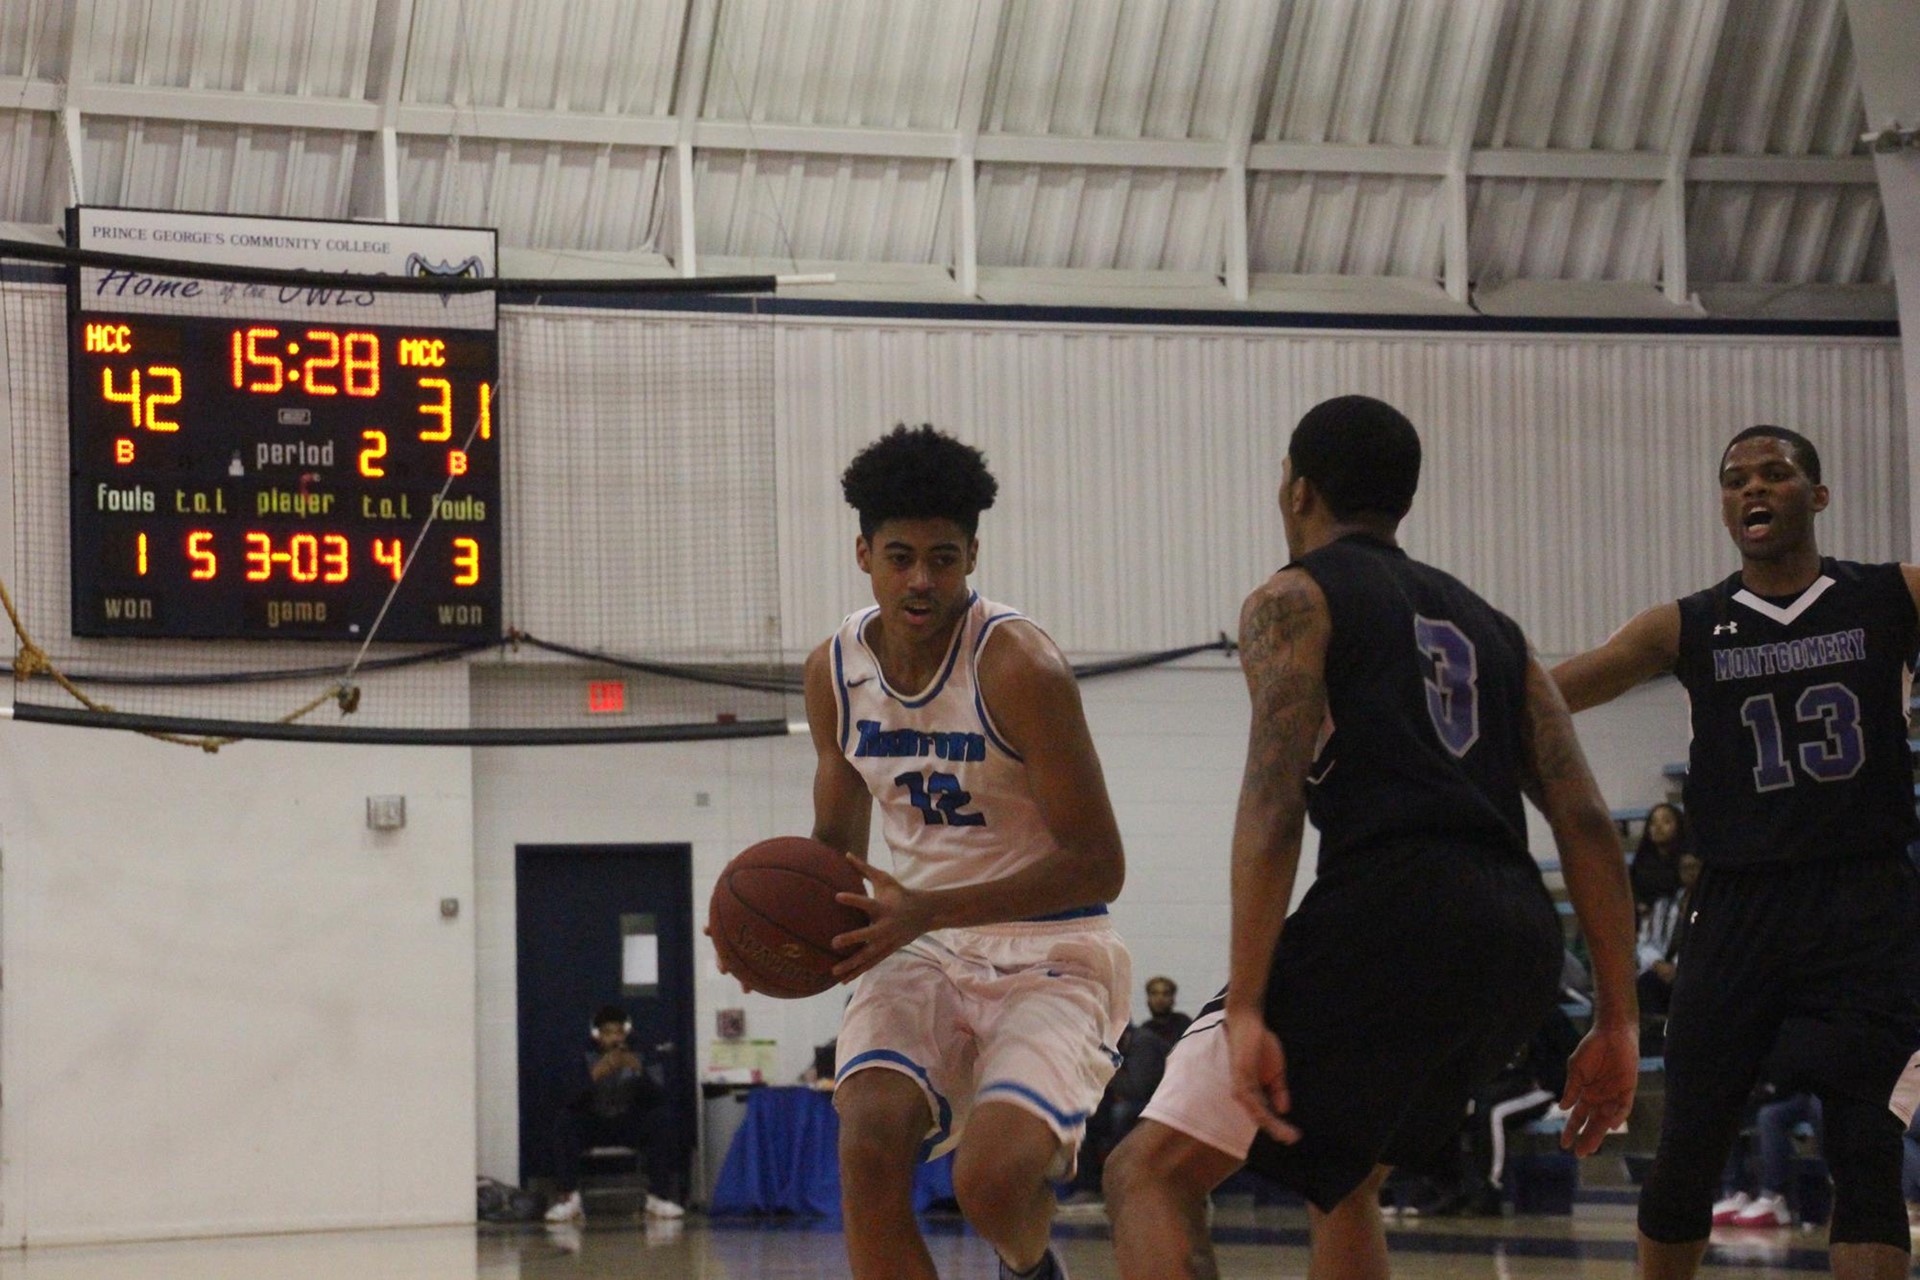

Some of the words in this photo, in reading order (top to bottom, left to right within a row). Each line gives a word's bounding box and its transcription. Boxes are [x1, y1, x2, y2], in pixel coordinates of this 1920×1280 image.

[92, 226, 147, 241] PRINCE
[152, 229, 225, 245] GEORGE'S
[230, 233, 321, 251] COMMUNITY
[326, 239, 391, 254] COLLEGE
[96, 268, 203, 298] Home
[85, 324, 131, 353] HCC
[399, 339, 446, 367] MCC
[231, 327, 380, 398] 15:28
[102, 366, 183, 433] 42
[418, 377, 493, 442] 31
[115, 438, 135, 465] B
[256, 440, 334, 470] period
[358, 429, 388, 478] 2
[447, 450, 468, 476] B
[97, 483, 155, 512] fouls
[257, 488, 335, 518] player
[433, 496, 486, 521] fouls
[137, 532, 148, 576] 1
[187, 531, 217, 580] 5
[245, 532, 350, 583] 3-03
[373, 538, 402, 582] 4
[453, 538, 480, 586] 3
[105, 597, 153, 620] won
[268, 602, 327, 628] game
[438, 604, 483, 626] won
[1713, 628, 1866, 681] MONTGOMERY
[1413, 612, 1480, 758] 3
[1740, 682, 1866, 793] 13
[895, 771, 987, 826] 12
